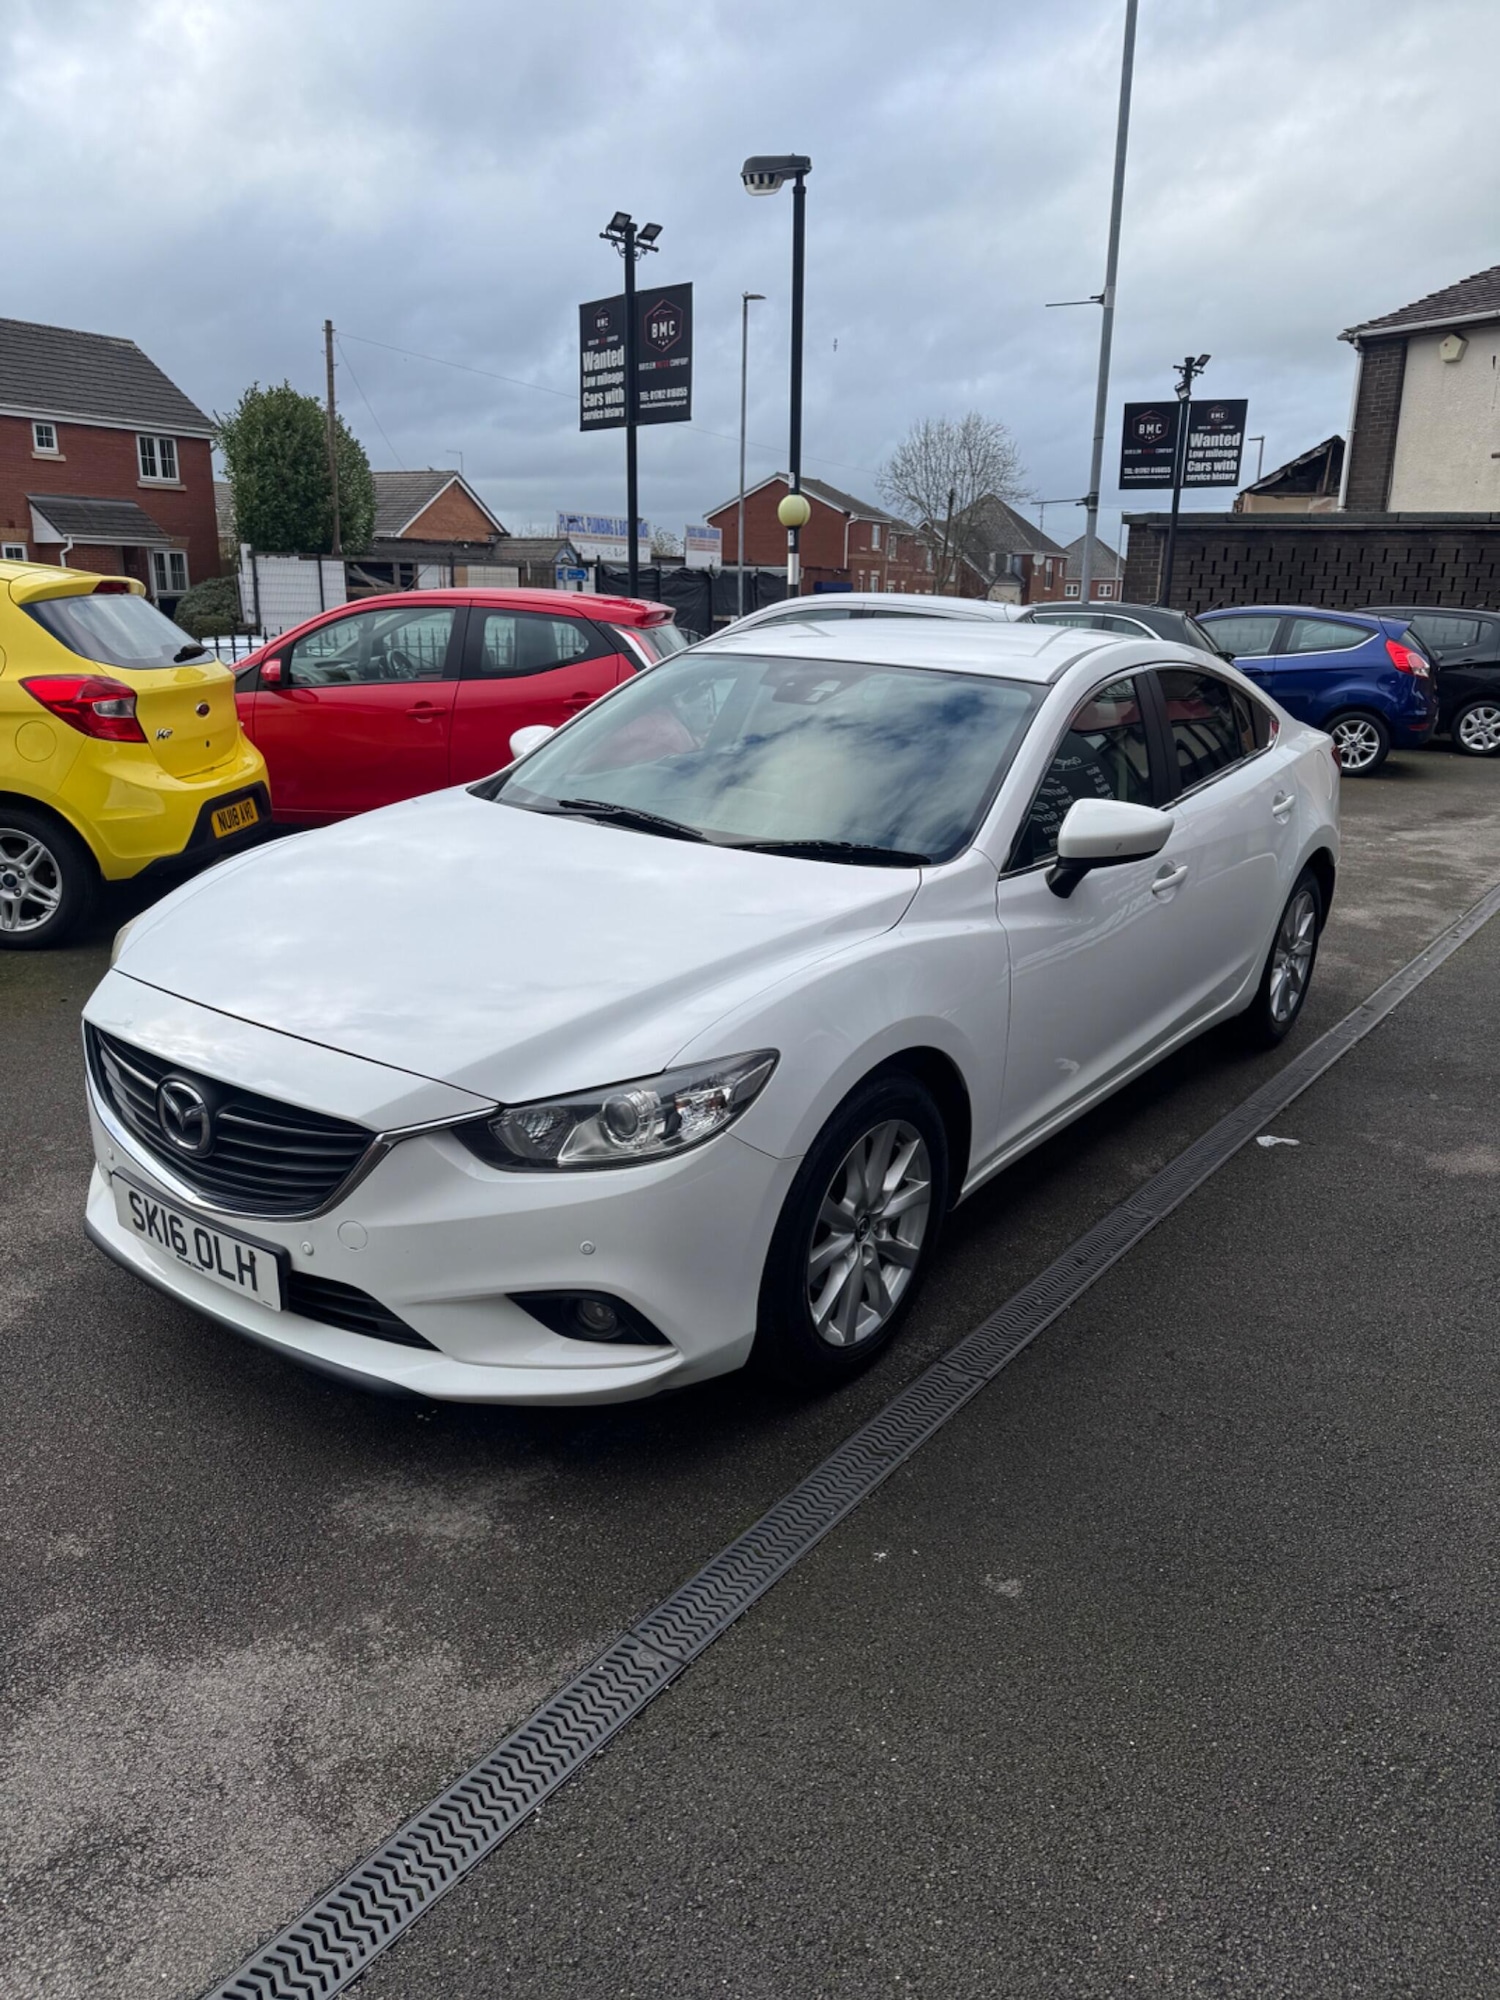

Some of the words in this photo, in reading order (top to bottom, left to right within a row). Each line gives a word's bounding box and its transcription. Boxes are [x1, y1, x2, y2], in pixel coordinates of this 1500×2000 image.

[651, 320, 676, 339] BMC
[582, 345, 625, 372] Wanted
[583, 374, 596, 388] Low
[597, 371, 625, 386] mileage
[583, 390, 604, 408] Cars
[604, 387, 625, 404] with
[583, 409, 603, 421] service
[604, 406, 625, 419] history
[1138, 423, 1162, 435] BMC
[1189, 432, 1241, 448] Wanted
[1188, 450, 1205, 459] Low
[1205, 448, 1239, 459] mileage
[1186, 461, 1212, 472] Cars
[1213, 459, 1237, 471] with
[1185, 473, 1211, 482] service
[1211, 472, 1237, 481] history
[216, 807, 240, 832] NU18
[128, 1190, 188, 1257] SK16
[193, 1227, 259, 1293] OLH
